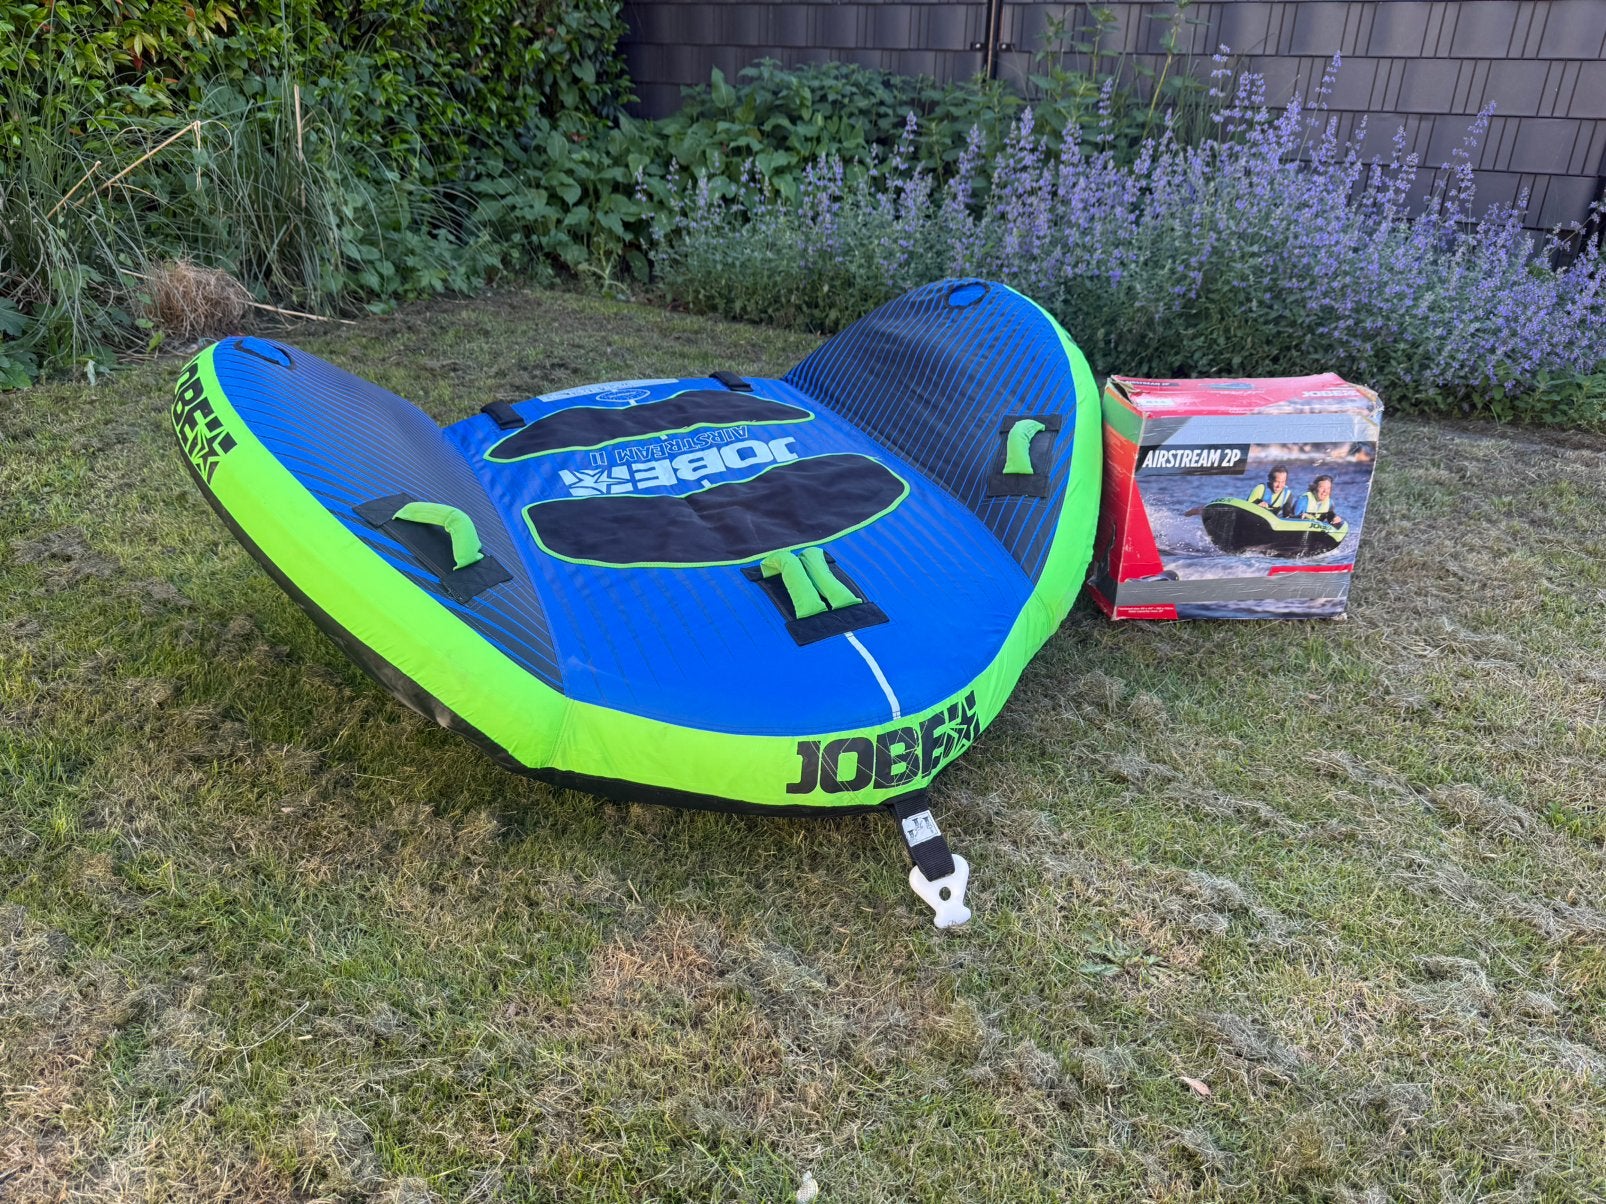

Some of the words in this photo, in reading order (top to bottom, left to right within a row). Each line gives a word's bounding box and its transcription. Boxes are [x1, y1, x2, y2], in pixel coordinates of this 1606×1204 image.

[615, 424, 749, 463] AIRSTREAM
[631, 437, 800, 488] JOBE
[1142, 449, 1221, 469] AIRSTREAM
[1221, 449, 1241, 467] 2P
[785, 710, 948, 795] JOBE
